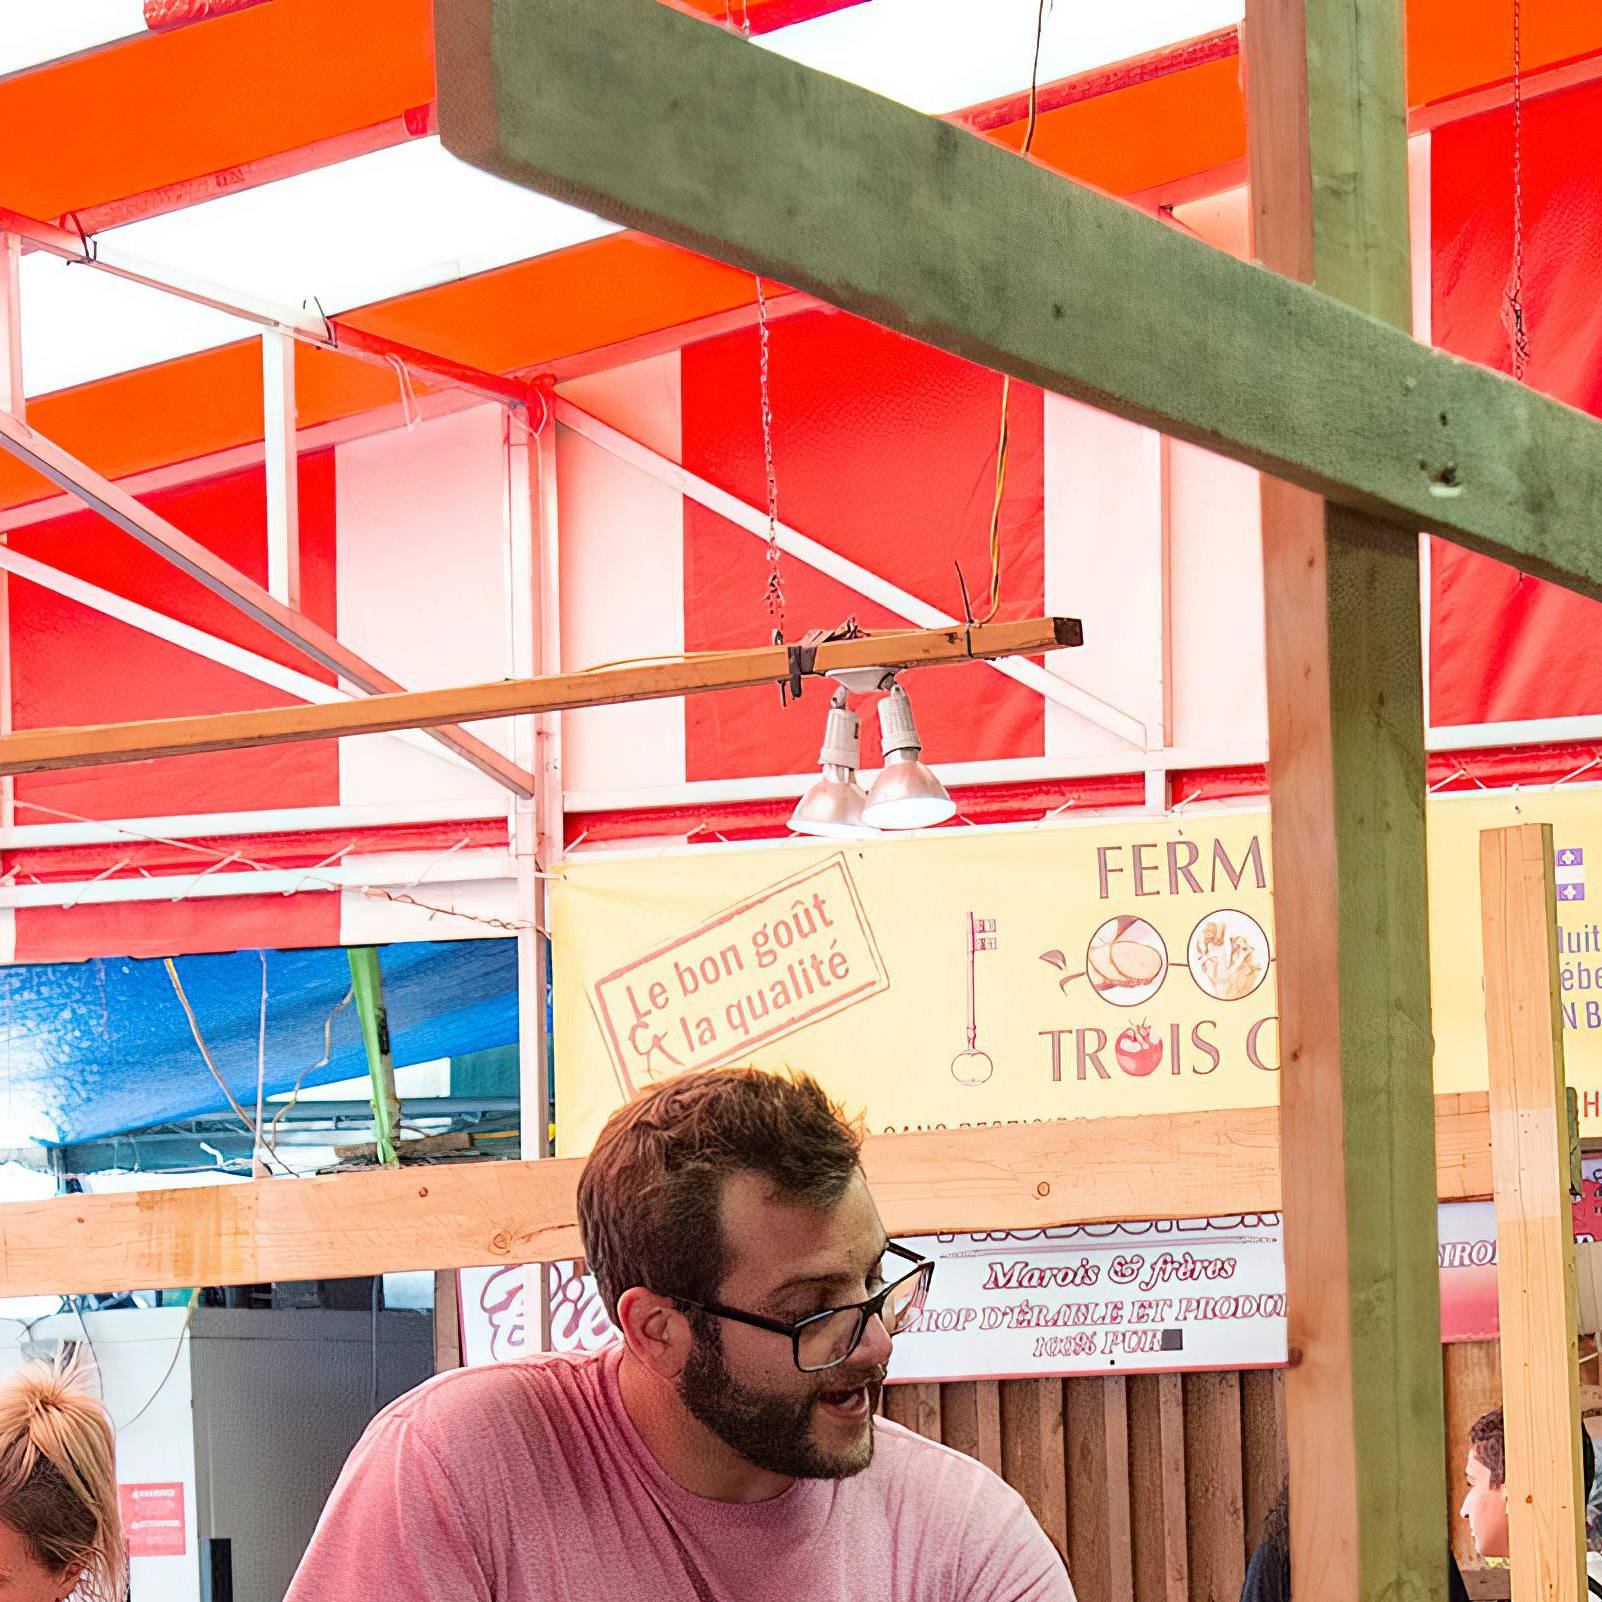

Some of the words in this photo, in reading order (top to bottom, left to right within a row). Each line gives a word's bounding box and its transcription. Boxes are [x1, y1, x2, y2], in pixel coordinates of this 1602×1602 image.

[627, 976, 671, 1020] Le
[674, 938, 745, 1003] bon
[751, 893, 834, 971] goût
[681, 1009, 717, 1053] la
[726, 939, 851, 1037] qualité
[983, 1257, 1100, 1290] Marois
[1108, 1255, 1144, 1284] &
[1128, 1298, 1173, 1324] ET
